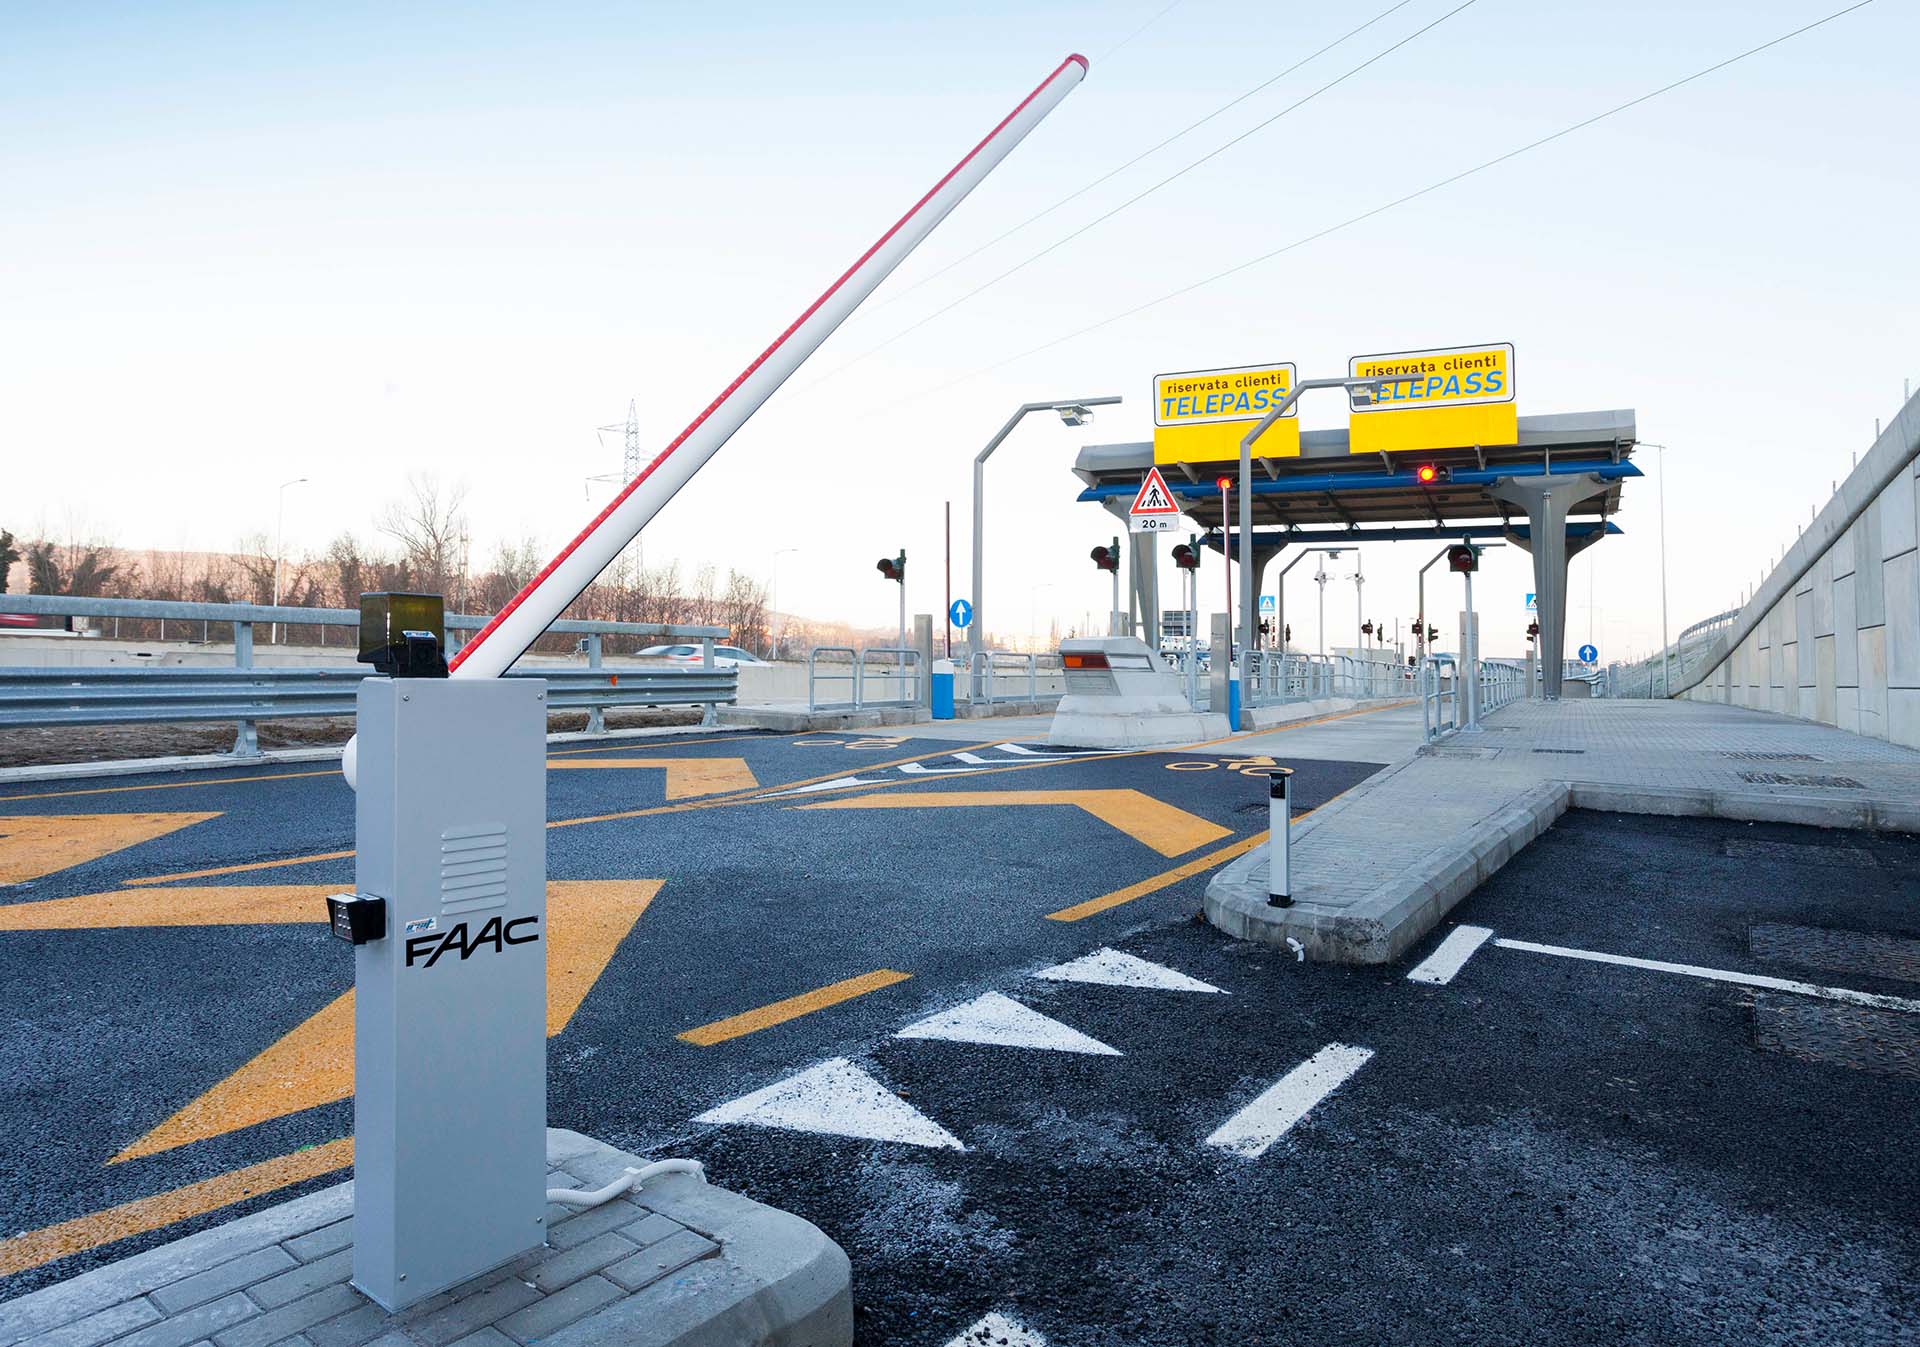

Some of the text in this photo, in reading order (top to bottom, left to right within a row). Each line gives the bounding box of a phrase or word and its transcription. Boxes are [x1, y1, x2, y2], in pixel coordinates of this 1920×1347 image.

[1366, 355, 1497, 377] riservata clienti
[1167, 373, 1281, 393] riservata clienti
[1376, 370, 1503, 401] ELEPASS
[1163, 387, 1287, 417] TELEPASS
[1142, 519, 1157, 529] 20
[405, 915, 539, 969] FAAC
